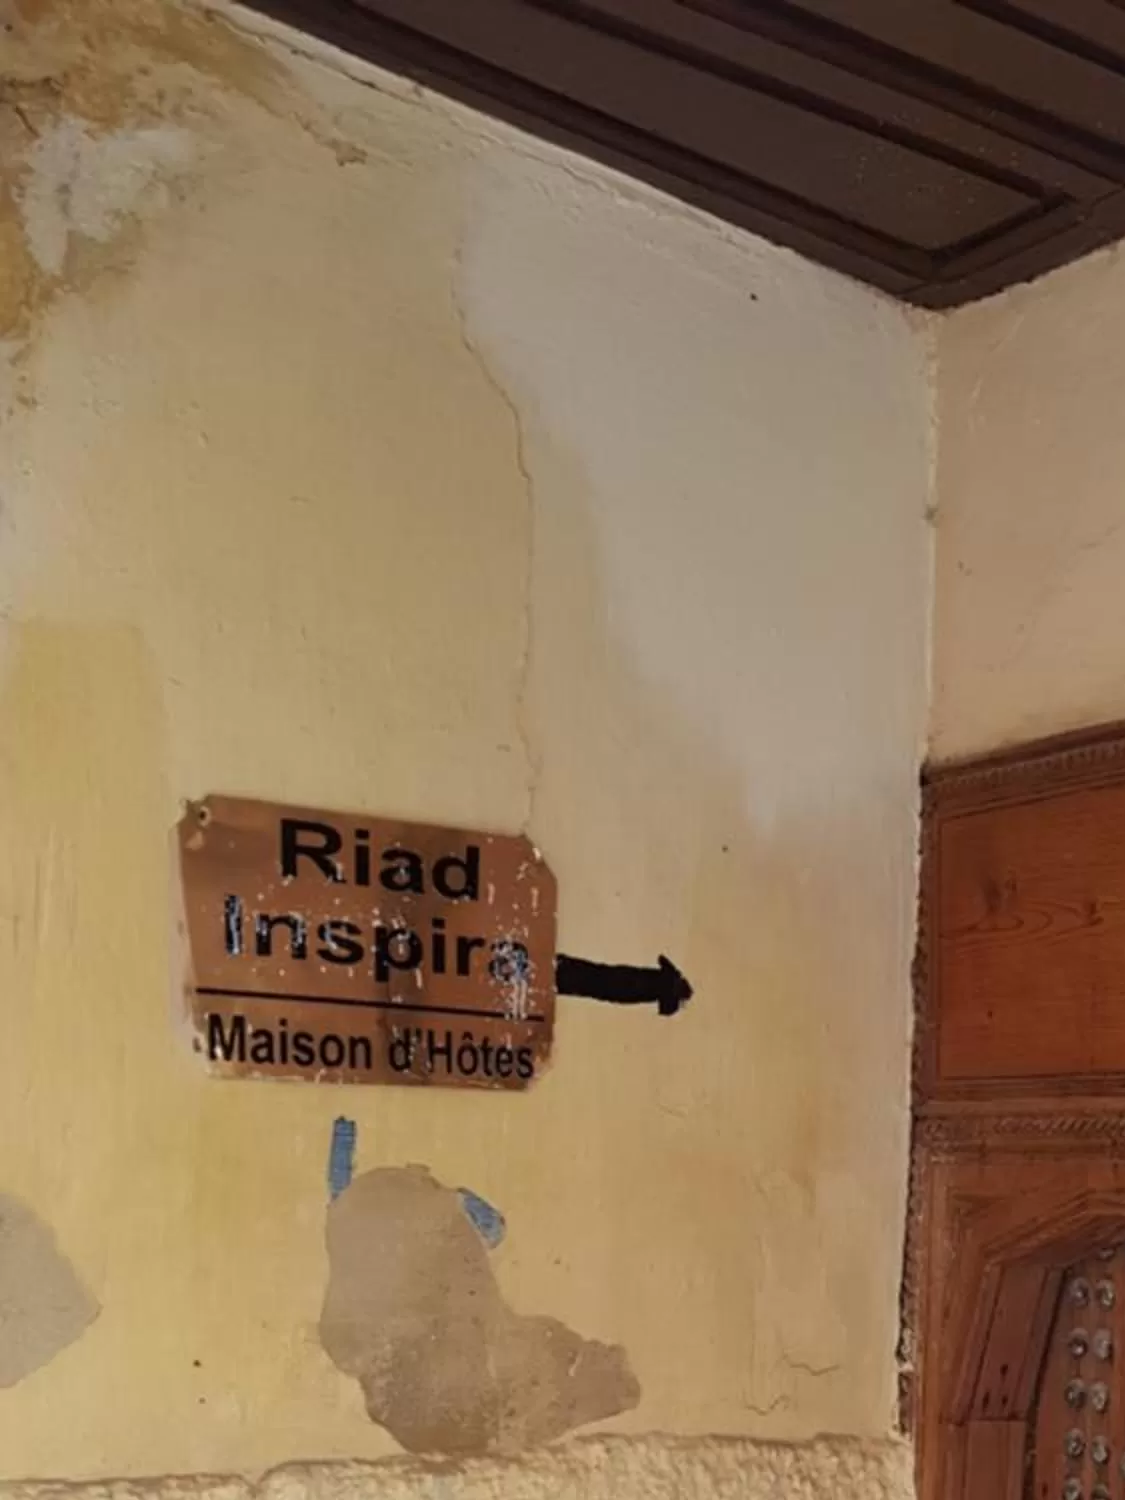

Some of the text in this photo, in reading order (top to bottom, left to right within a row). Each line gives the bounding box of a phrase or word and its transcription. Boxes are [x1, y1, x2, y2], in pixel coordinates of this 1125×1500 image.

[279, 817, 480, 901] Riad
[224, 894, 529, 983] Inspira
[207, 1012, 535, 1080] Maison d'Hôtes
